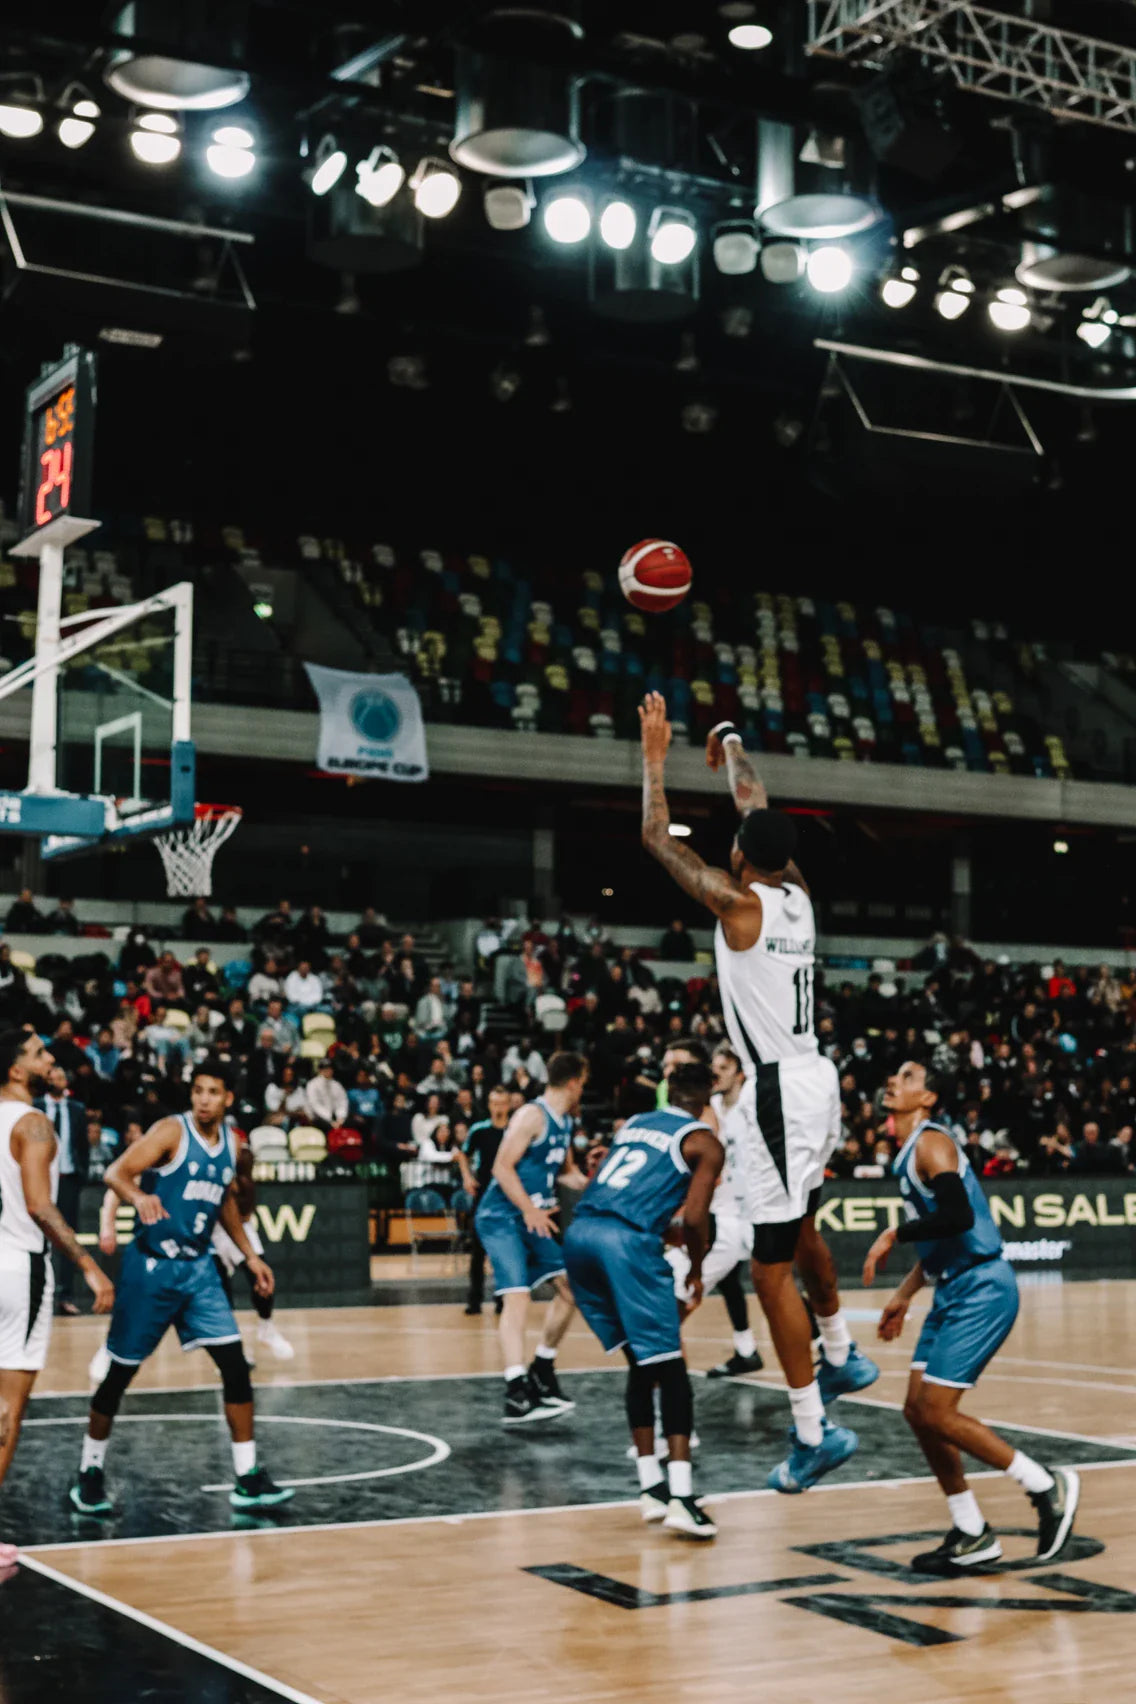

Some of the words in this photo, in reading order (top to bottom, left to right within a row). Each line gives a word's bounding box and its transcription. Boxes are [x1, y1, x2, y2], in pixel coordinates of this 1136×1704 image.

[36, 441, 73, 527] 24
[327, 756, 388, 772] EUROPE
[393, 762, 423, 776] CUP
[793, 968, 809, 1035] 11
[597, 1146, 648, 1191] 12
[193, 1212, 208, 1234] 5
[253, 1204, 316, 1242] W
